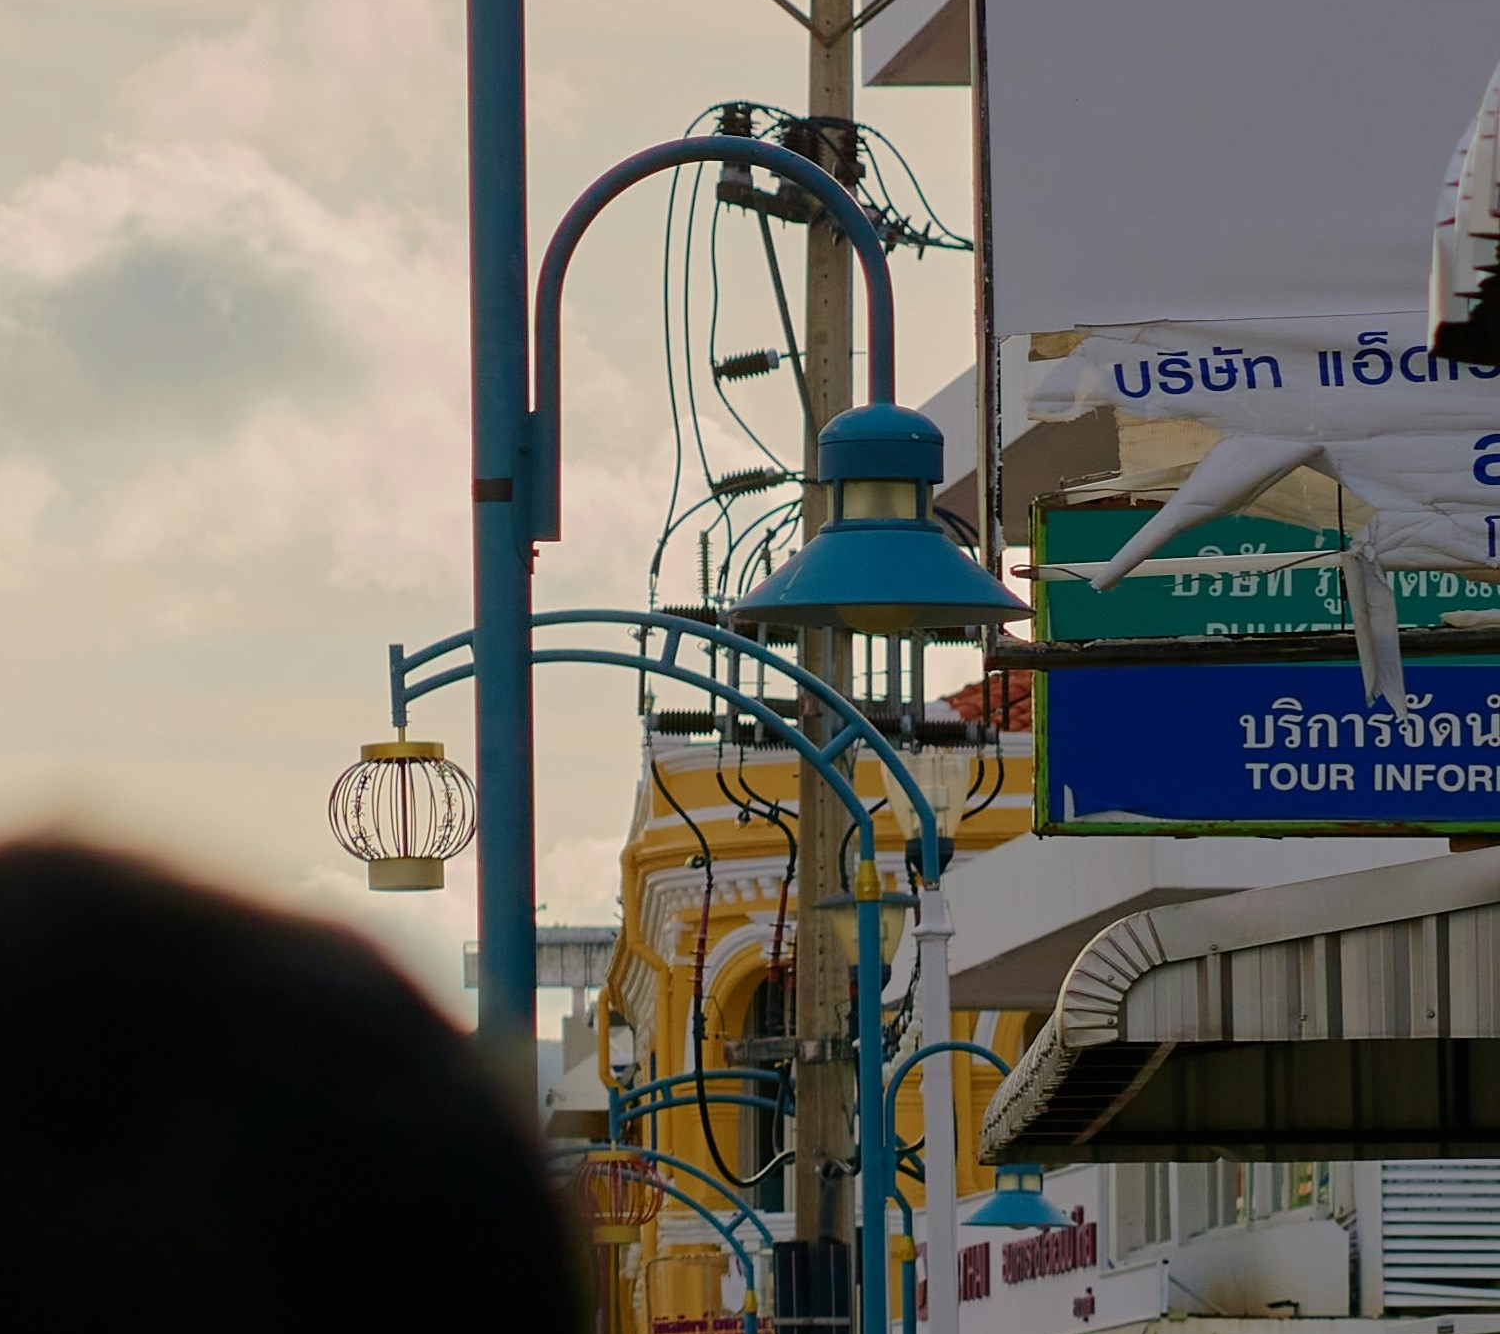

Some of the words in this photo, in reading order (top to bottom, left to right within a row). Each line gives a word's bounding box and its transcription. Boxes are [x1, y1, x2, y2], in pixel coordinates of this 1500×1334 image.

[1114, 346, 1283, 398] บริษัท
[1245, 762, 1355, 791] TOUR
[1374, 763, 1500, 792] INFOR
